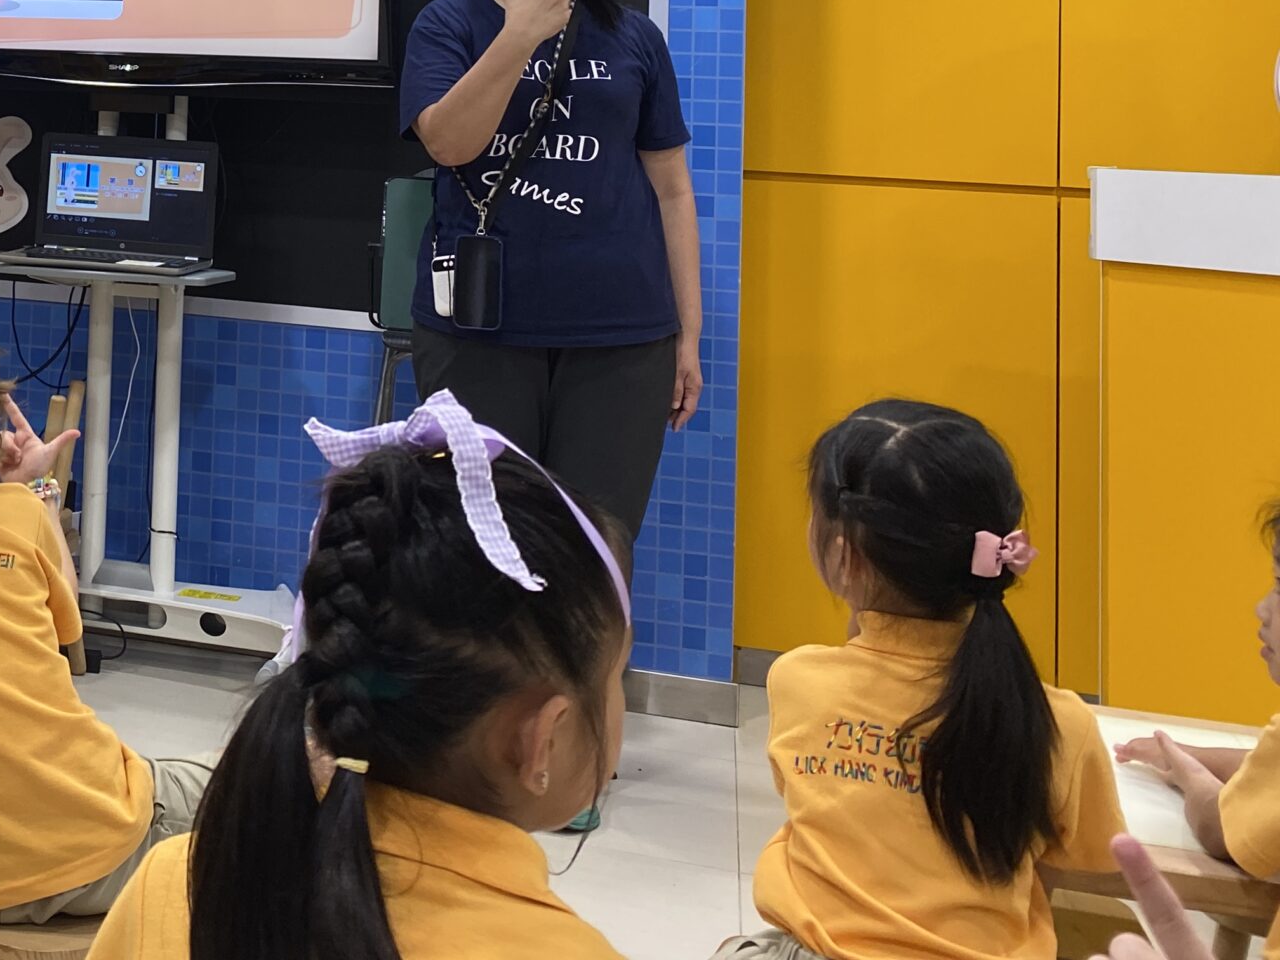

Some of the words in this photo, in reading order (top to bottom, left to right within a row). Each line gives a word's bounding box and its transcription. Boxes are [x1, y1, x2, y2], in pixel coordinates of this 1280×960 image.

[108, 63, 140, 71] SHARP
[794, 755, 828, 775] LICK
[834, 759, 878, 784] HANG
